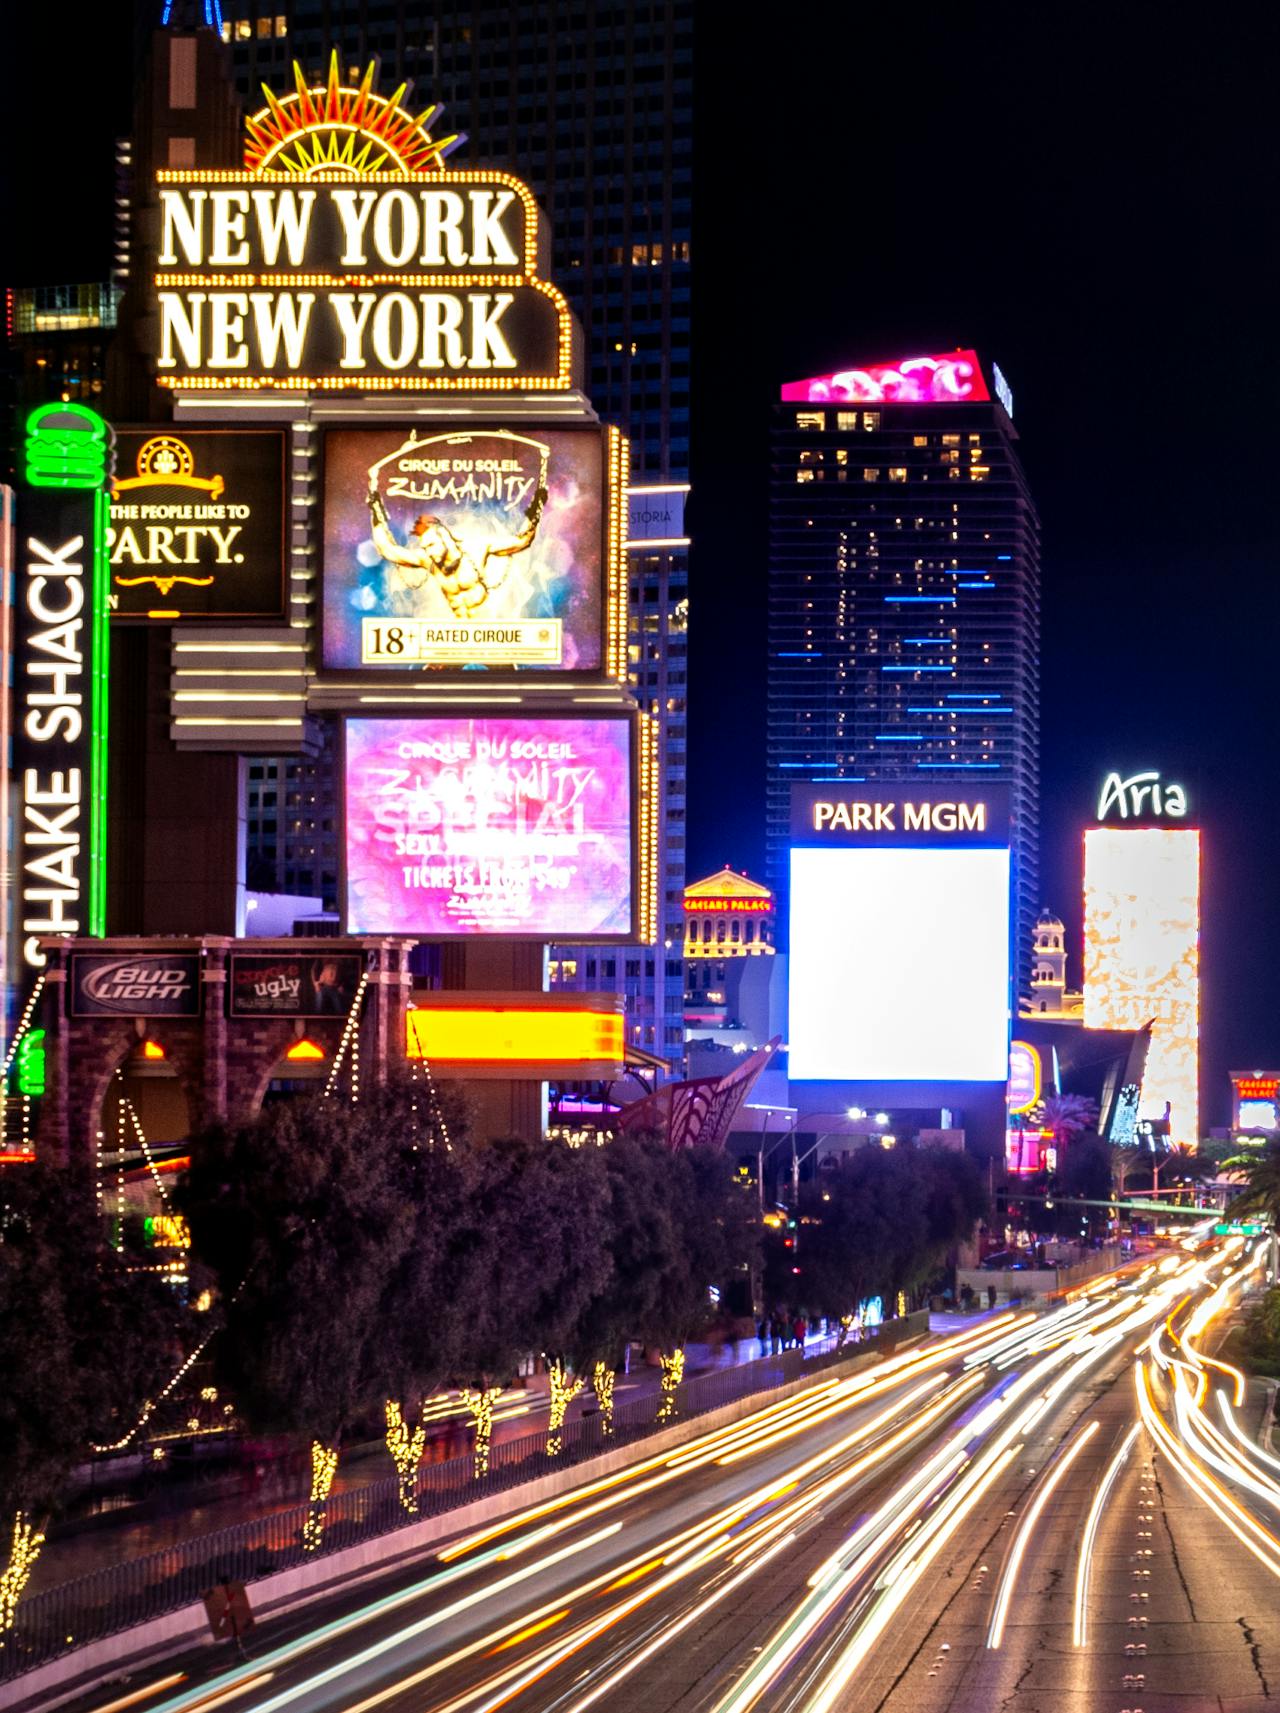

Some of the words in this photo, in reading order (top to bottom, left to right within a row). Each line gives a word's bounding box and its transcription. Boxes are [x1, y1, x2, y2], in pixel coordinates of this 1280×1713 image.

[158, 189, 317, 267] NEW
[331, 189, 519, 267] YORK
[157, 291, 315, 369] NEW
[331, 291, 517, 369] YORK
[398, 459, 450, 475] CIRQUE
[452, 459, 474, 472] DU
[475, 459, 523, 472] SOLEIL
[109, 504, 139, 520] THE
[141, 504, 193, 520] PEOPLE
[194, 504, 226, 520] LIKE
[226, 504, 250, 520] TO
[24, 534, 85, 742] SHACK
[426, 629, 469, 644] RATED
[473, 629, 523, 644] CIRQUE
[398, 742, 471, 764] CIRQUE
[476, 742, 508, 759] DU
[510, 742, 578, 759] SOLEIL
[1096, 772, 1188, 821] Aria
[813, 803, 896, 832] PARK
[903, 803, 986, 832] MGM
[395, 833, 441, 855] SEXY
[402, 865, 475, 889] TICKETS
[683, 900, 728, 911] CAESARS
[111, 968, 187, 984] BUD
[254, 974, 301, 998] ugly
[95, 984, 191, 1000] LIGHT
